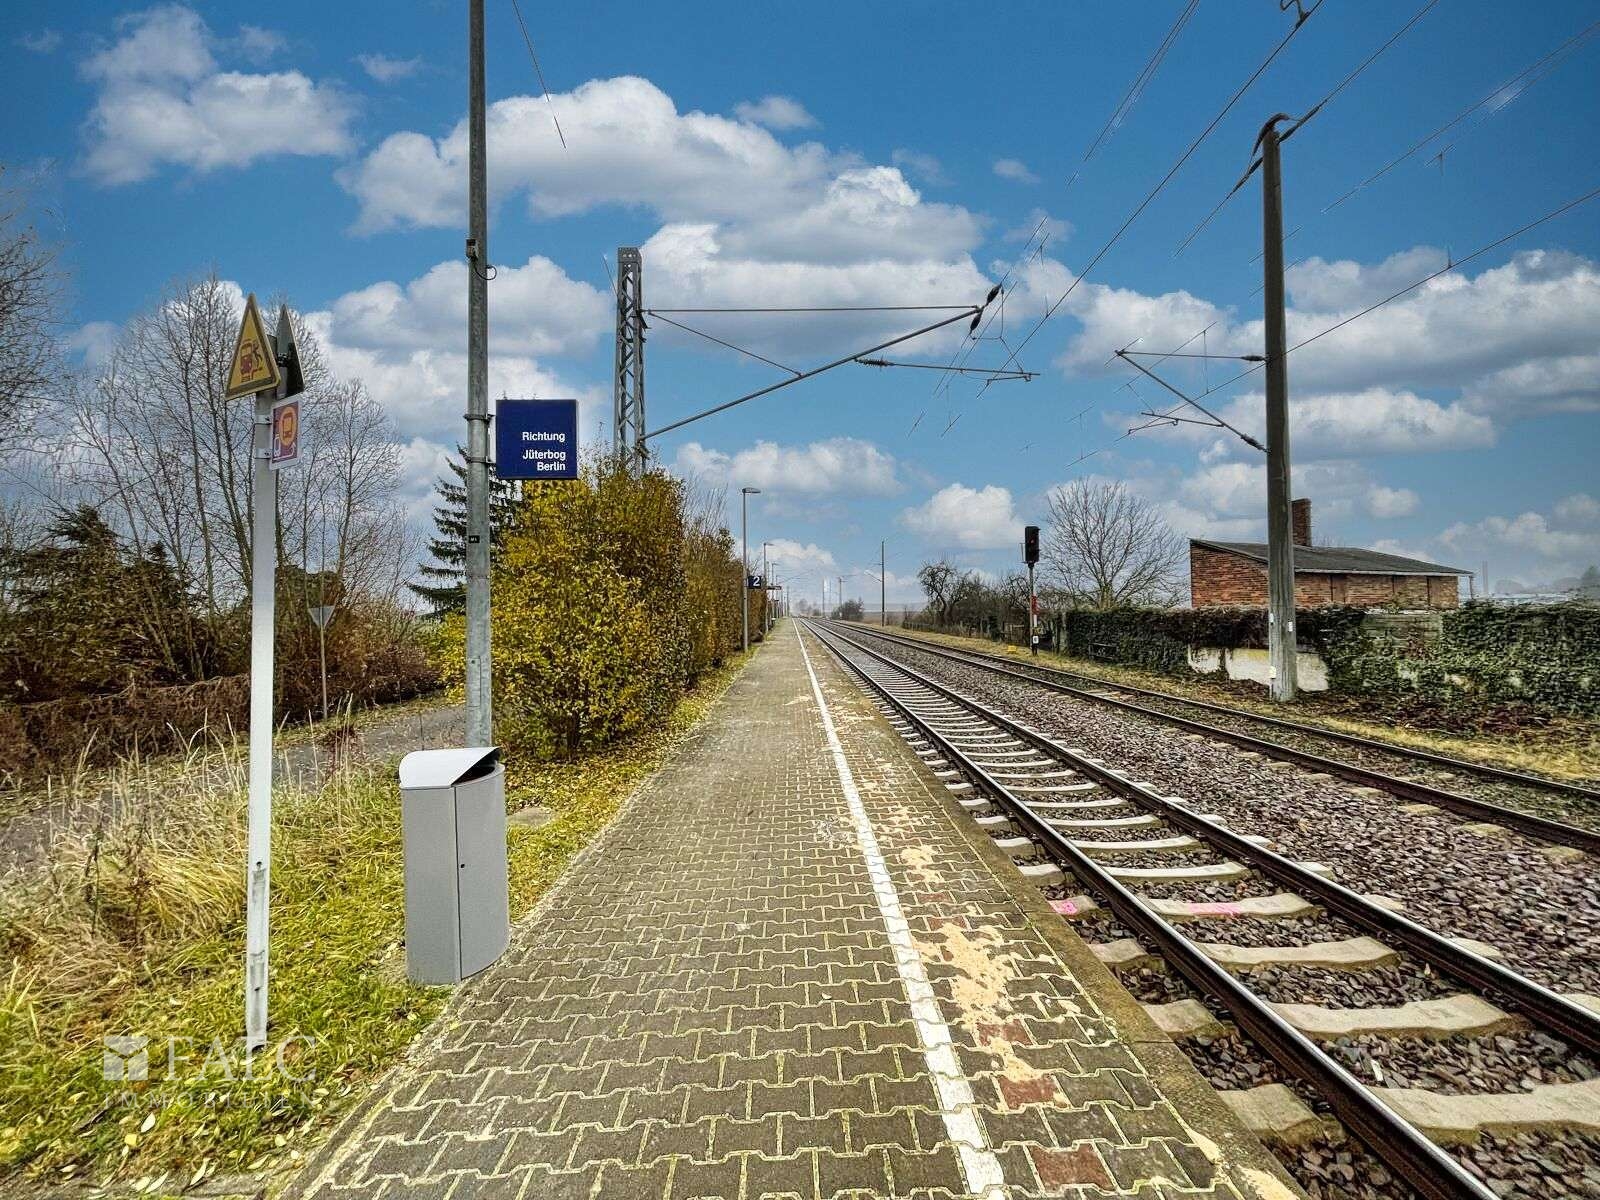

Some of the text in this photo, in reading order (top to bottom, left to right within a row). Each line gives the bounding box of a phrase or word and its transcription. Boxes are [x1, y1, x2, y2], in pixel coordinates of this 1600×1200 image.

[522, 431, 566, 443] Richtung
[522, 449, 566, 461] Jüterbog
[537, 461, 566, 471] Berlin
[752, 576, 761, 587] 2
